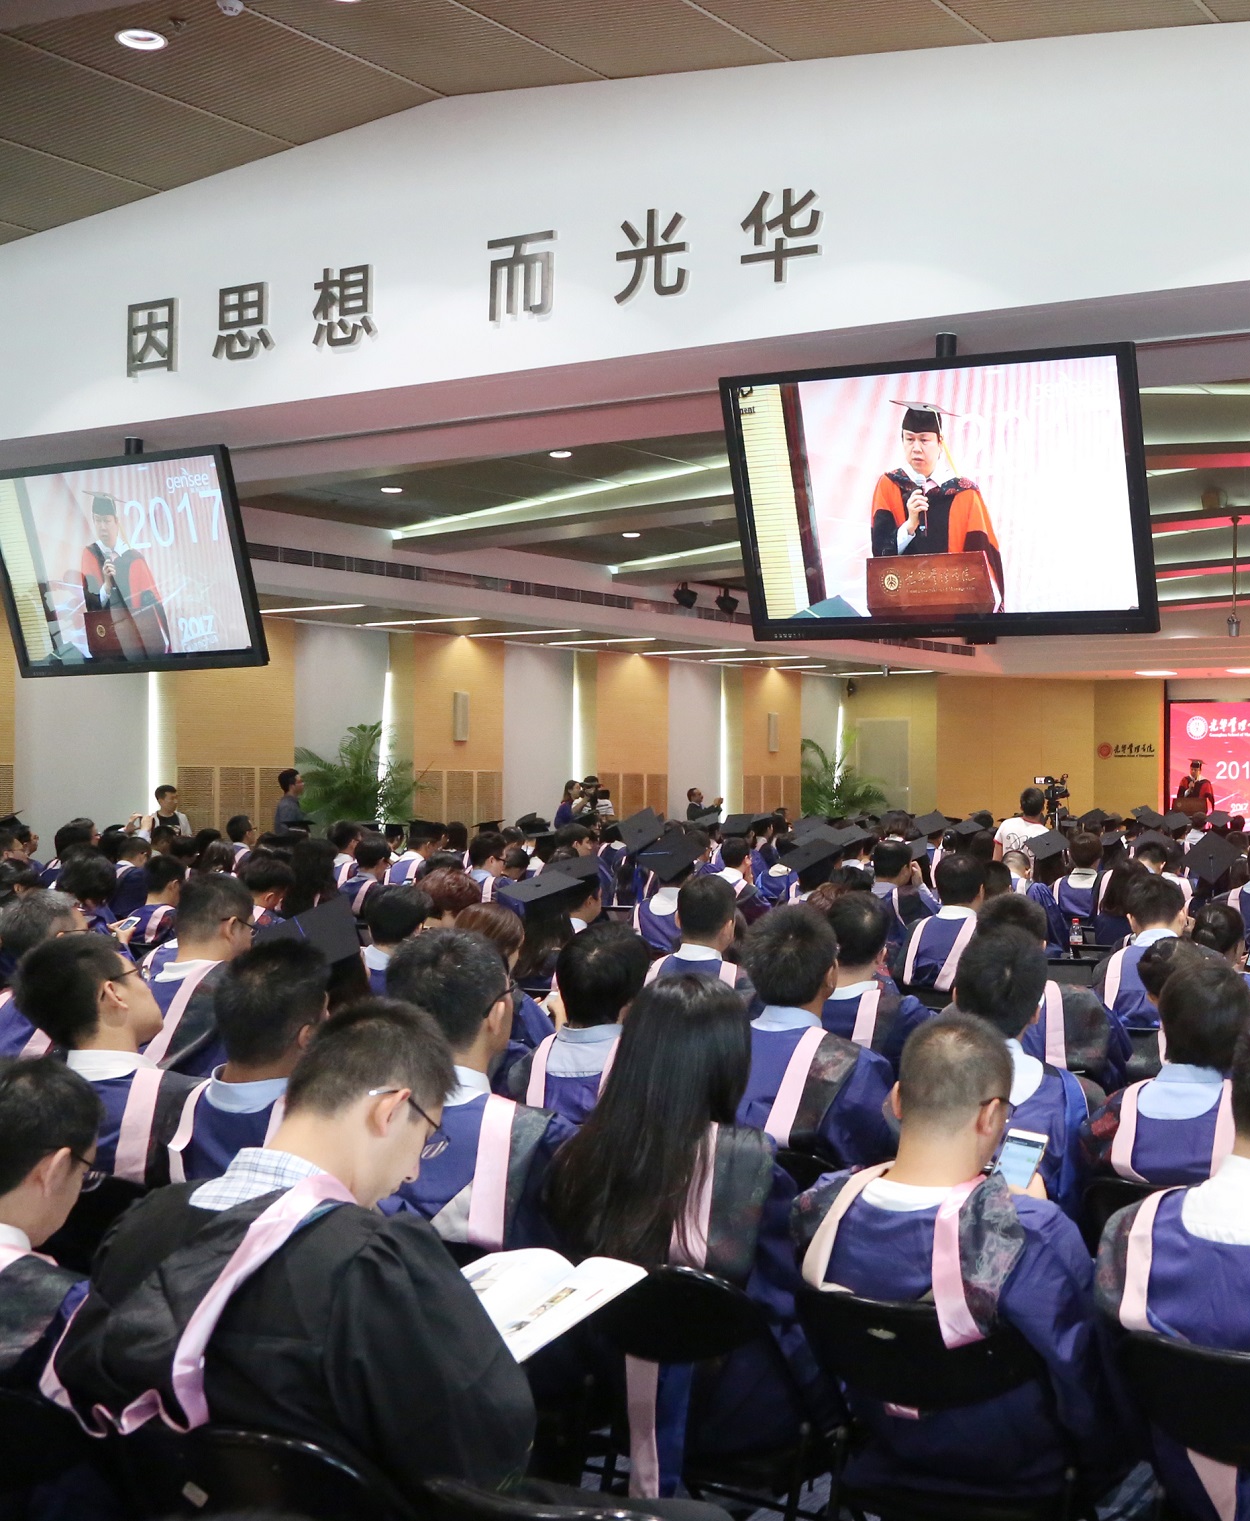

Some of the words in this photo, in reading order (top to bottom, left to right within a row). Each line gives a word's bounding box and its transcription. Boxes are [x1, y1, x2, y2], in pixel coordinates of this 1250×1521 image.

[127, 264, 378, 378] 因思想
[487, 188, 824, 321] 而光华
[166, 472, 209, 493] gensee
[123, 488, 221, 549] 2017
[178, 614, 215, 642] 2017
